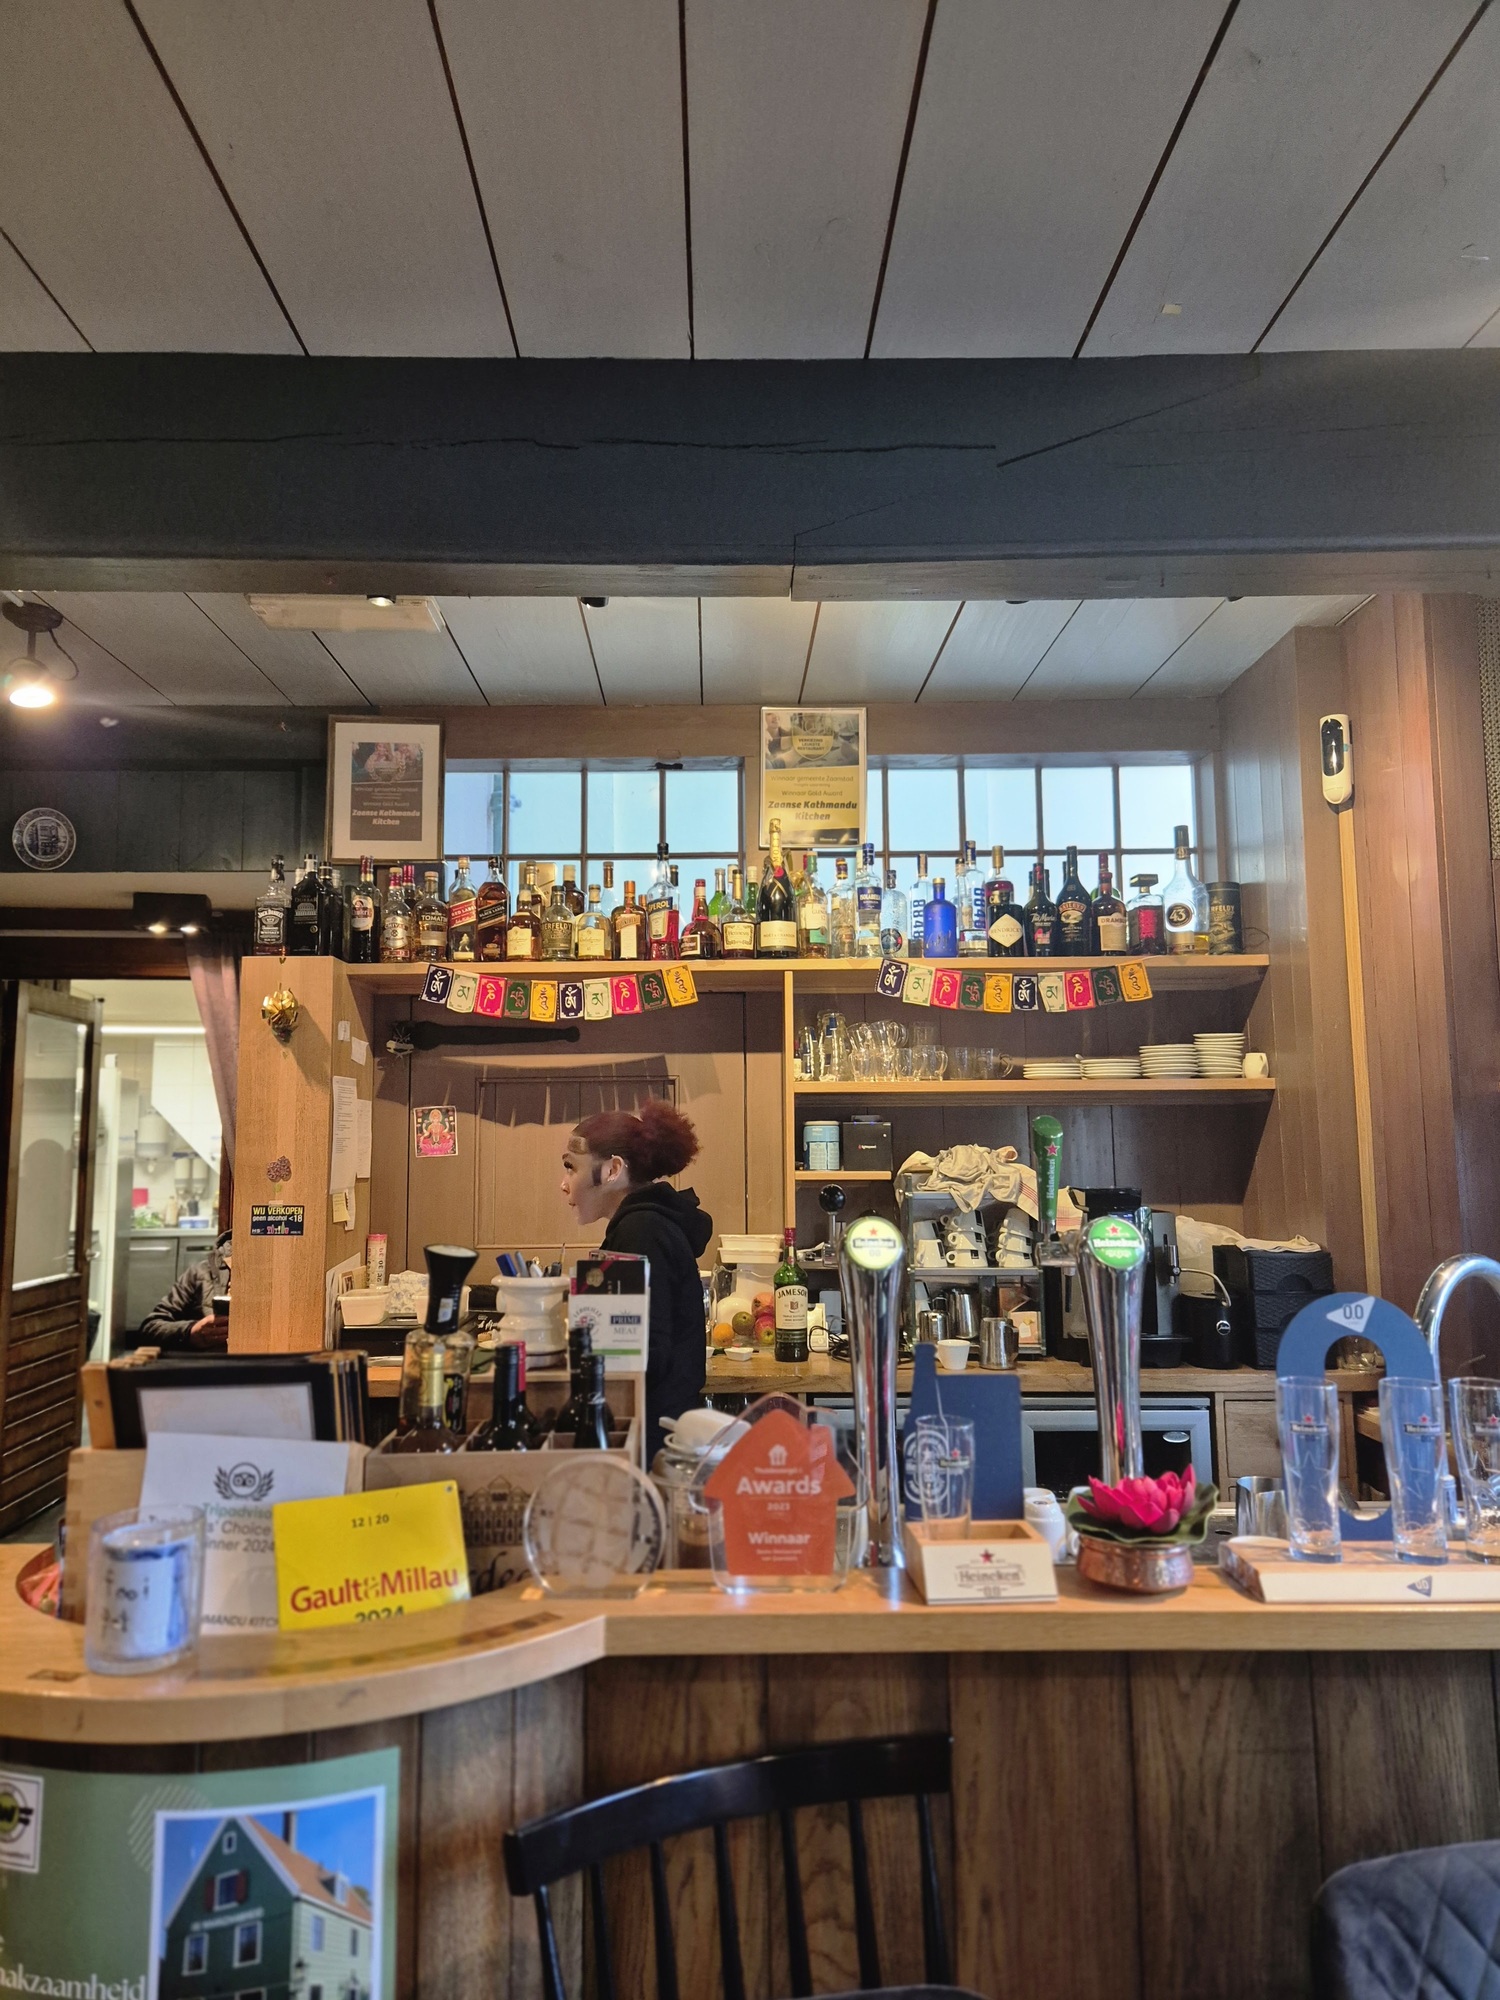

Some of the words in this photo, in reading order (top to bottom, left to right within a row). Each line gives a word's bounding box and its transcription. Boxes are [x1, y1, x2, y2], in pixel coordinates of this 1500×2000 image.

[768, 801, 802, 809] Zaanse
[803, 800, 858, 809] Kathmandu
[378, 809, 420, 817] Kathmandu
[795, 811, 831, 820] Kitchen
[1169, 909, 1186, 921] 43
[1046, 1158, 1056, 1199] Heineken
[267, 1206, 303, 1215] VERKOPEN
[777, 1288, 807, 1299] JAMESON
[1342, 1304, 1364, 1320] 0.0
[612, 1316, 640, 1324] PRIME
[736, 1474, 821, 1496] Awards
[351, 1517, 365, 1529] 12
[376, 1514, 390, 1525] 20
[221, 1521, 271, 1536] Choice
[747, 1531, 811, 1545] Winnaar
[959, 1570, 1020, 1583] Heineken
